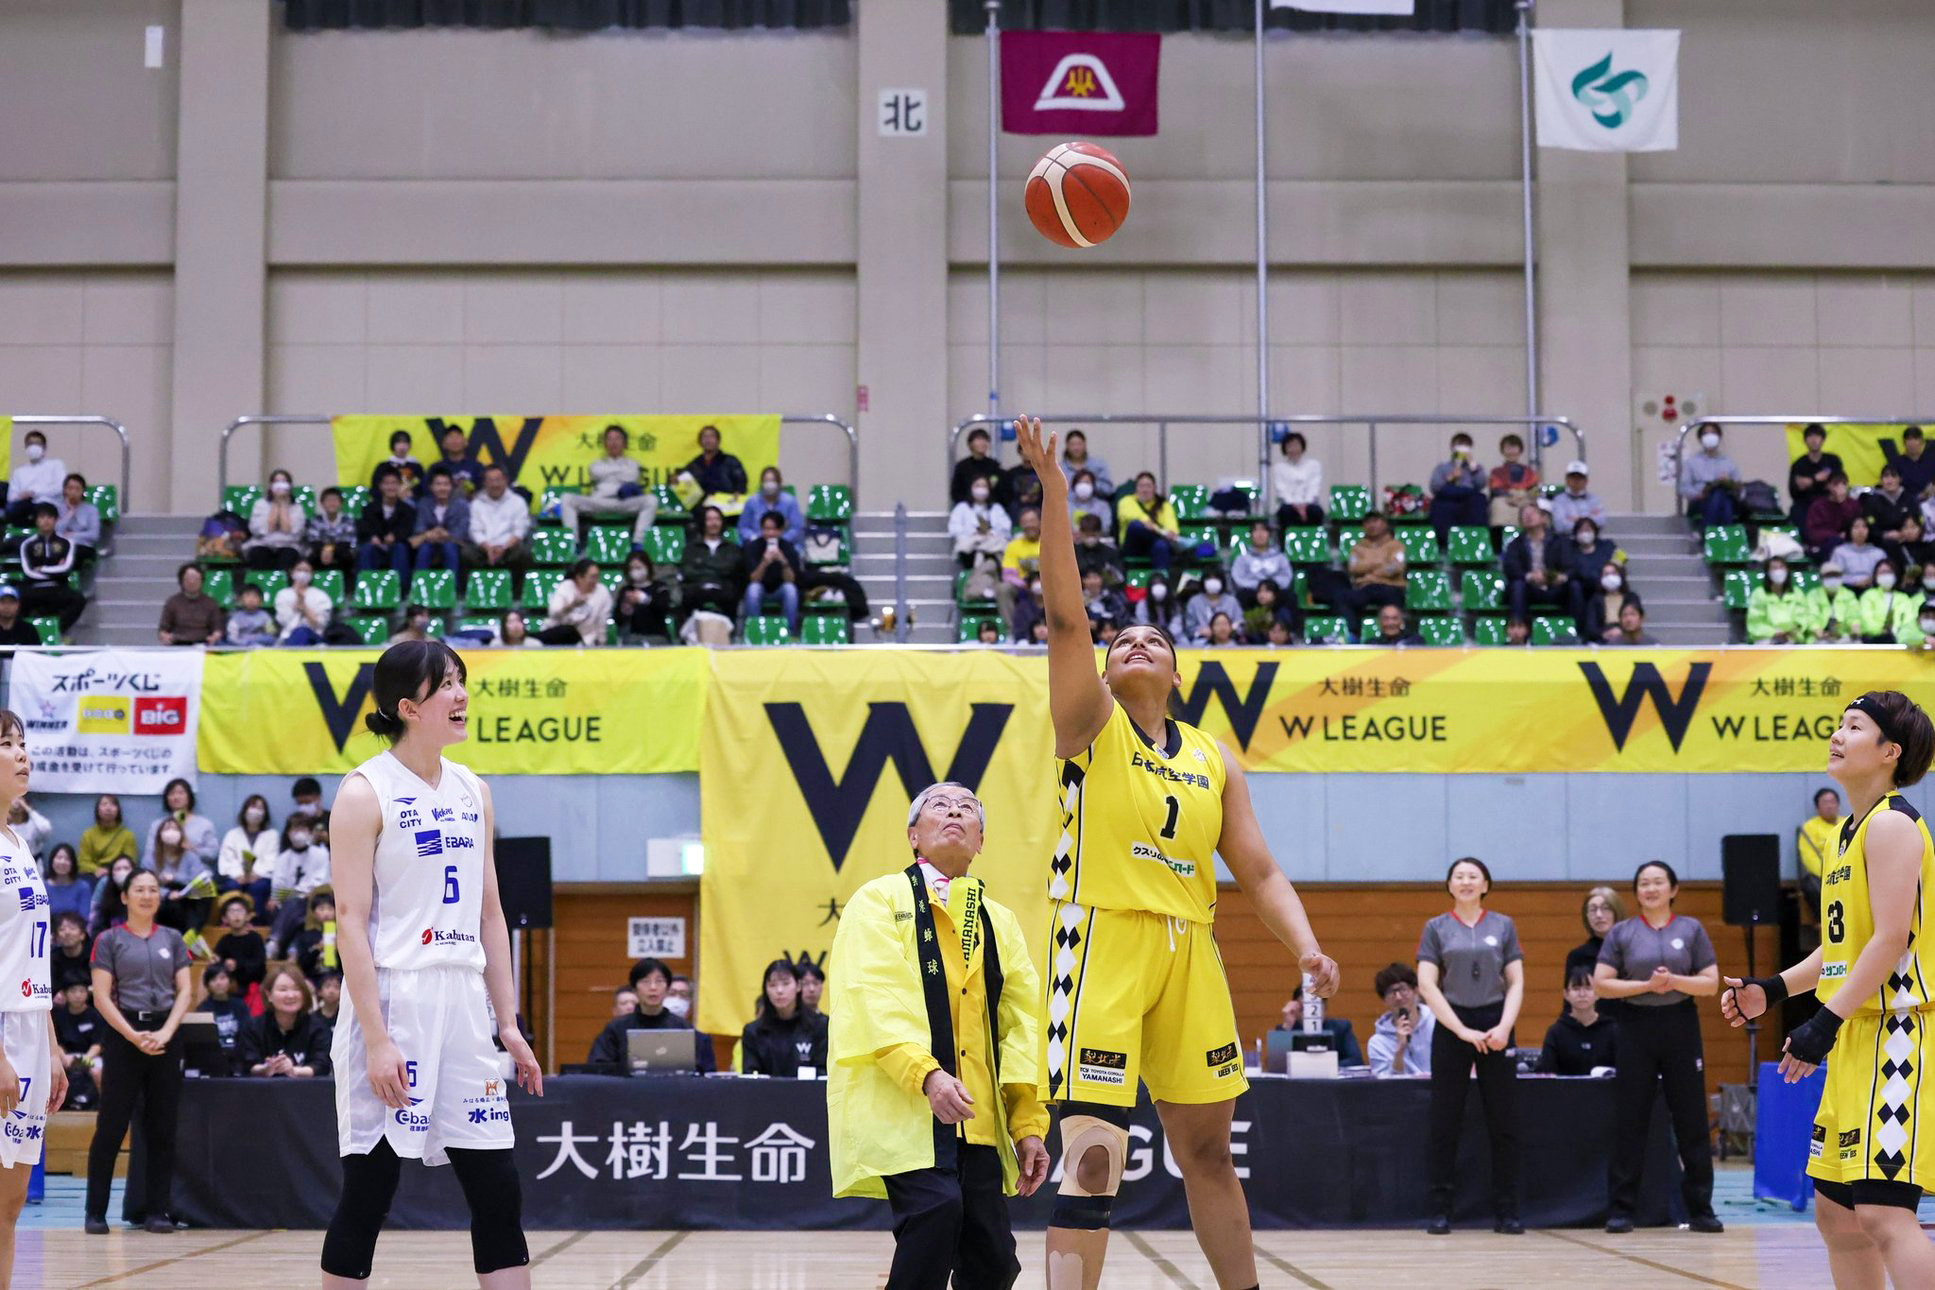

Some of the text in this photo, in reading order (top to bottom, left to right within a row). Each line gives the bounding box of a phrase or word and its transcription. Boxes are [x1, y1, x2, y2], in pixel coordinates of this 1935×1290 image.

[884, 95, 921, 131] 北
[52, 668, 161, 693] スポーツくじ
[474, 678, 568, 698] 大樹生命
[1318, 677, 1411, 697] 大樹生命
[1750, 677, 1842, 697] 大樹生命
[1577, 662, 1713, 754] W
[477, 716, 602, 742] LEAGUE
[1280, 716, 1446, 741] W LEAGUE
[1712, 717, 1746, 739] W
[400, 809, 418, 818] OTA
[400, 819, 422, 829] CITY
[1160, 796, 1179, 839] 1
[442, 865, 460, 904] 6
[1827, 900, 1844, 943] 3
[31, 921, 47, 958] 17
[1082, 1073, 1123, 1084] YAMANASHI
[536, 1121, 816, 1183] 大樹生命
